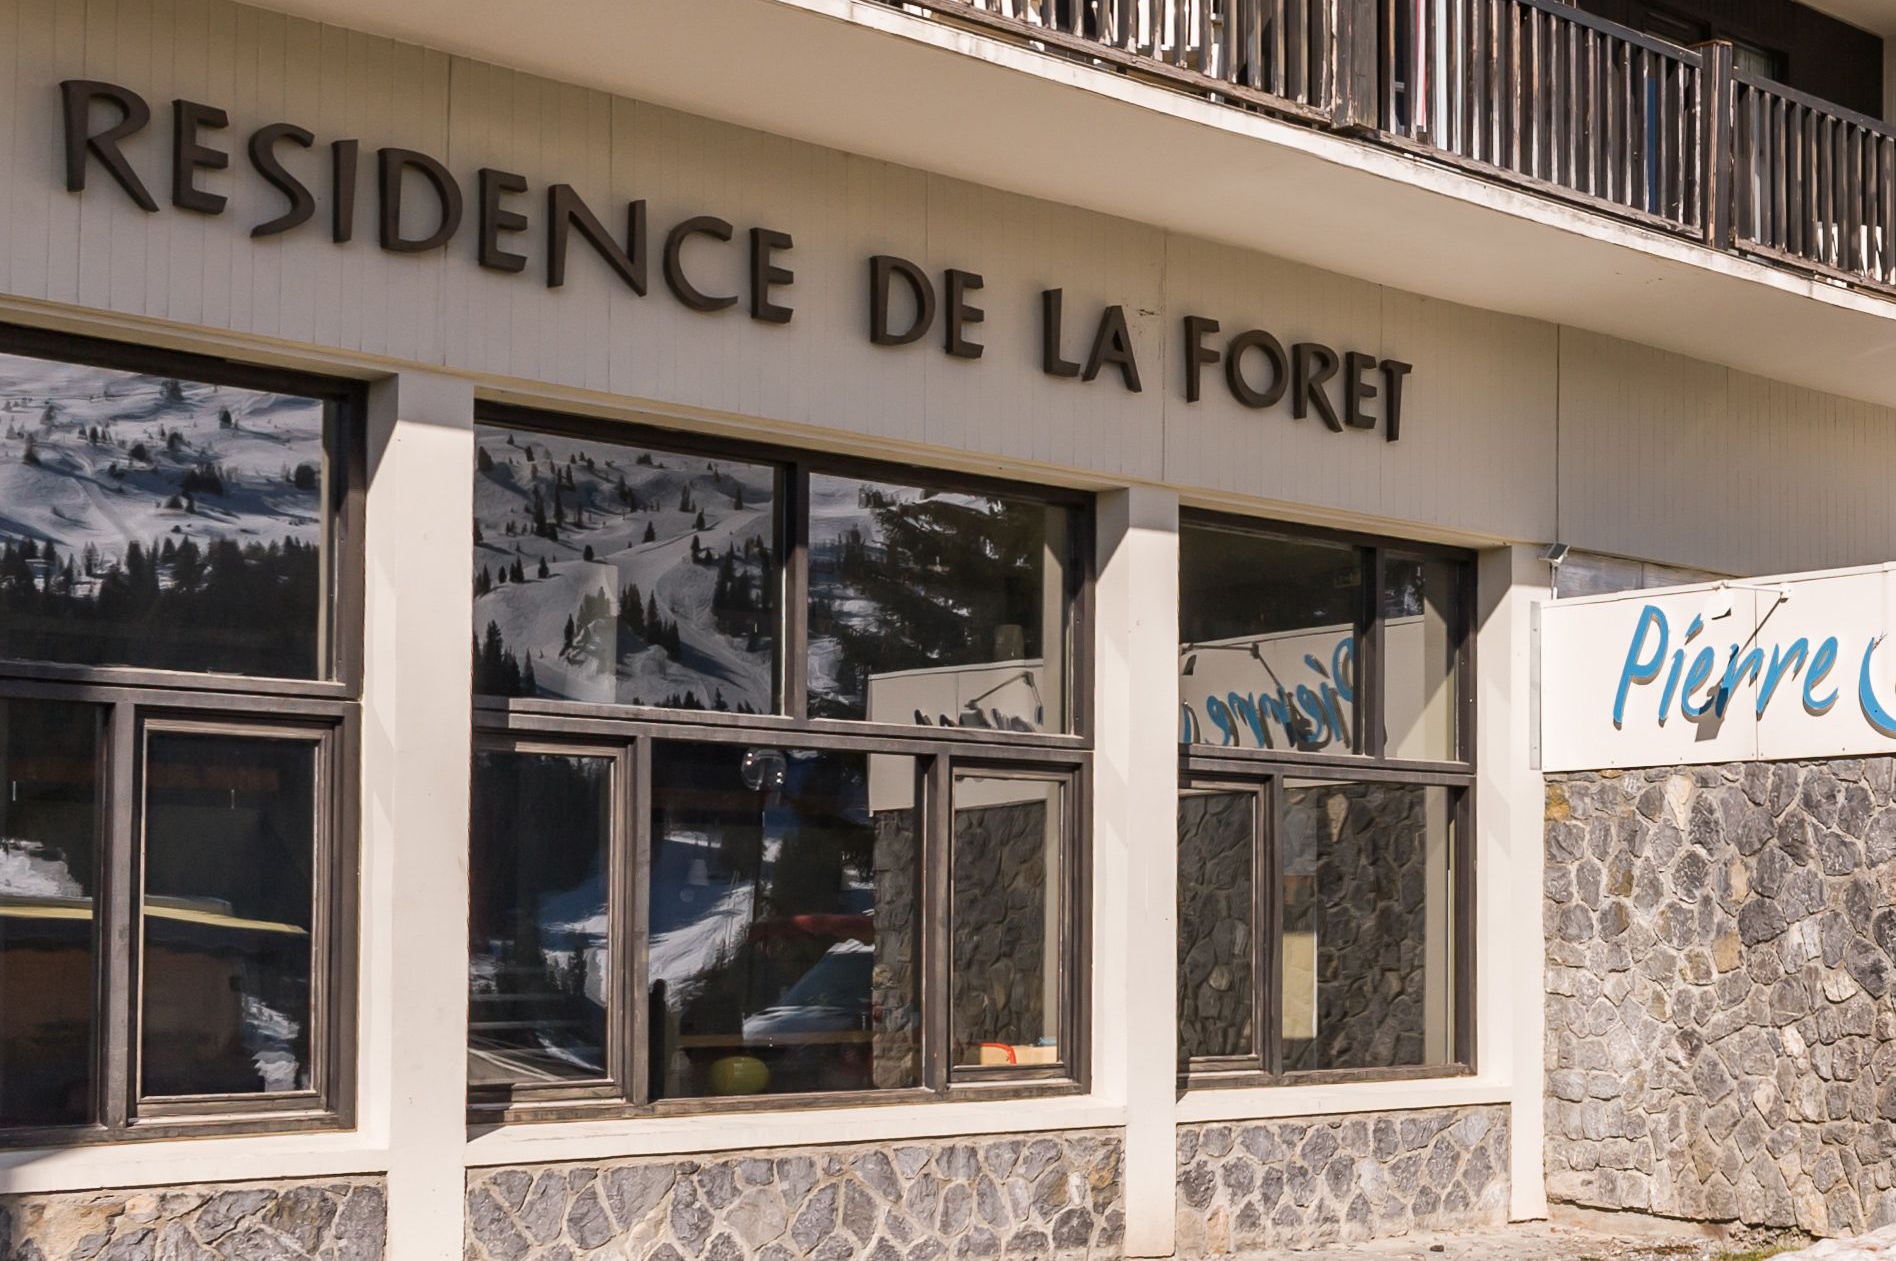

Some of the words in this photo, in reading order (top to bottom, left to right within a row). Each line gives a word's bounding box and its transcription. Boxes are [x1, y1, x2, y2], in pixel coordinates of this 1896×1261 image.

[60, 79, 794, 325] RESIDENCE
[868, 254, 985, 359] DE
[1042, 287, 1143, 393] LA
[1183, 314, 1412, 443] FORET
[1612, 604, 1840, 724] Pierre
